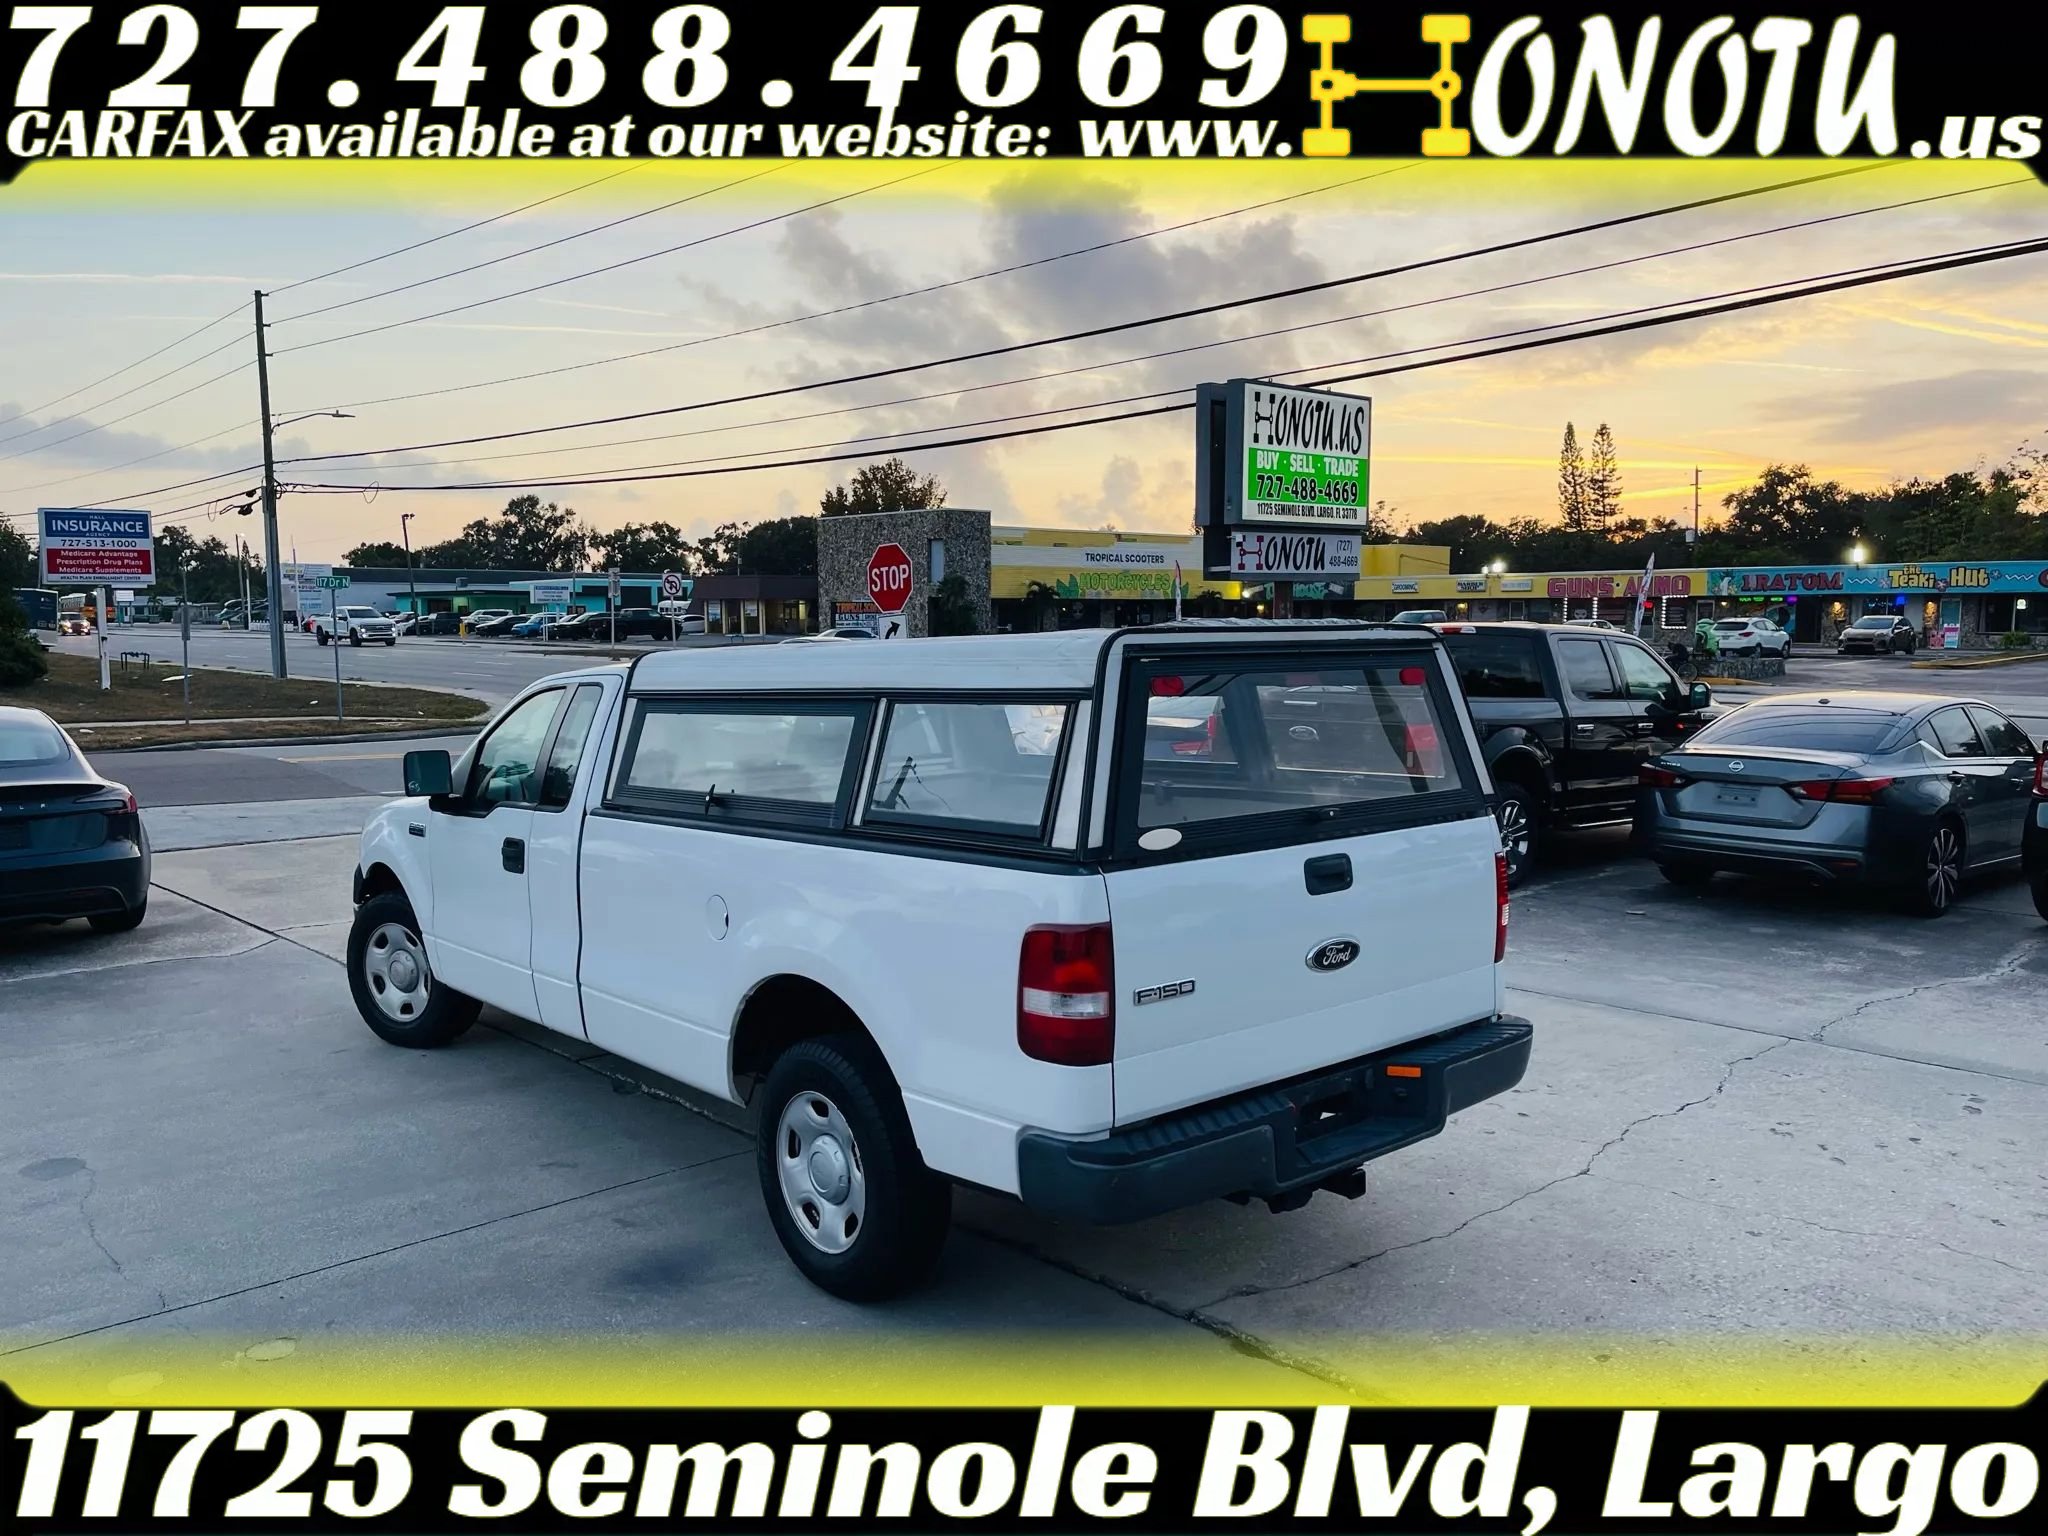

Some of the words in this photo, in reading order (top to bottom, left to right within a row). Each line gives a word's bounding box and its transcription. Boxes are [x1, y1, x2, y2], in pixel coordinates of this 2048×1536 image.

[1256, 451, 1279, 471] BUY
[1289, 454, 1315, 473] SELL
[1323, 457, 1359, 477] TRADE
[1256, 474, 1358, 504] 727-488-4669
[1257, 502, 1273, 515] 11725
[1274, 504, 1300, 516] SEMINOLE
[1335, 508, 1341, 518] FL
[51, 520, 144, 532] INSURANCE
[60, 539, 137, 548] 727-513-1000
[1336, 539, 1353, 553] (727)
[56, 558, 102, 566] Prescription
[103, 558, 122, 566] Drug
[1085, 552, 1124, 563] TROPICAL
[1125, 554, 1165, 564] SCOOTERS
[1328, 555, 1359, 568] 488-4669
[95, 566, 142, 574] Supplements
[1950, 566, 1990, 588] Hut
[316, 577, 328, 587] 117
[329, 577, 340, 587] Dr
[342, 578, 349, 587] N
[871, 564, 910, 592] STOP
[1080, 572, 1171, 591] MOTORCYCLES
[1547, 576, 1614, 598] GUNS
[1623, 574, 1691, 597] AMO
[1322, 944, 1351, 966] Ford
